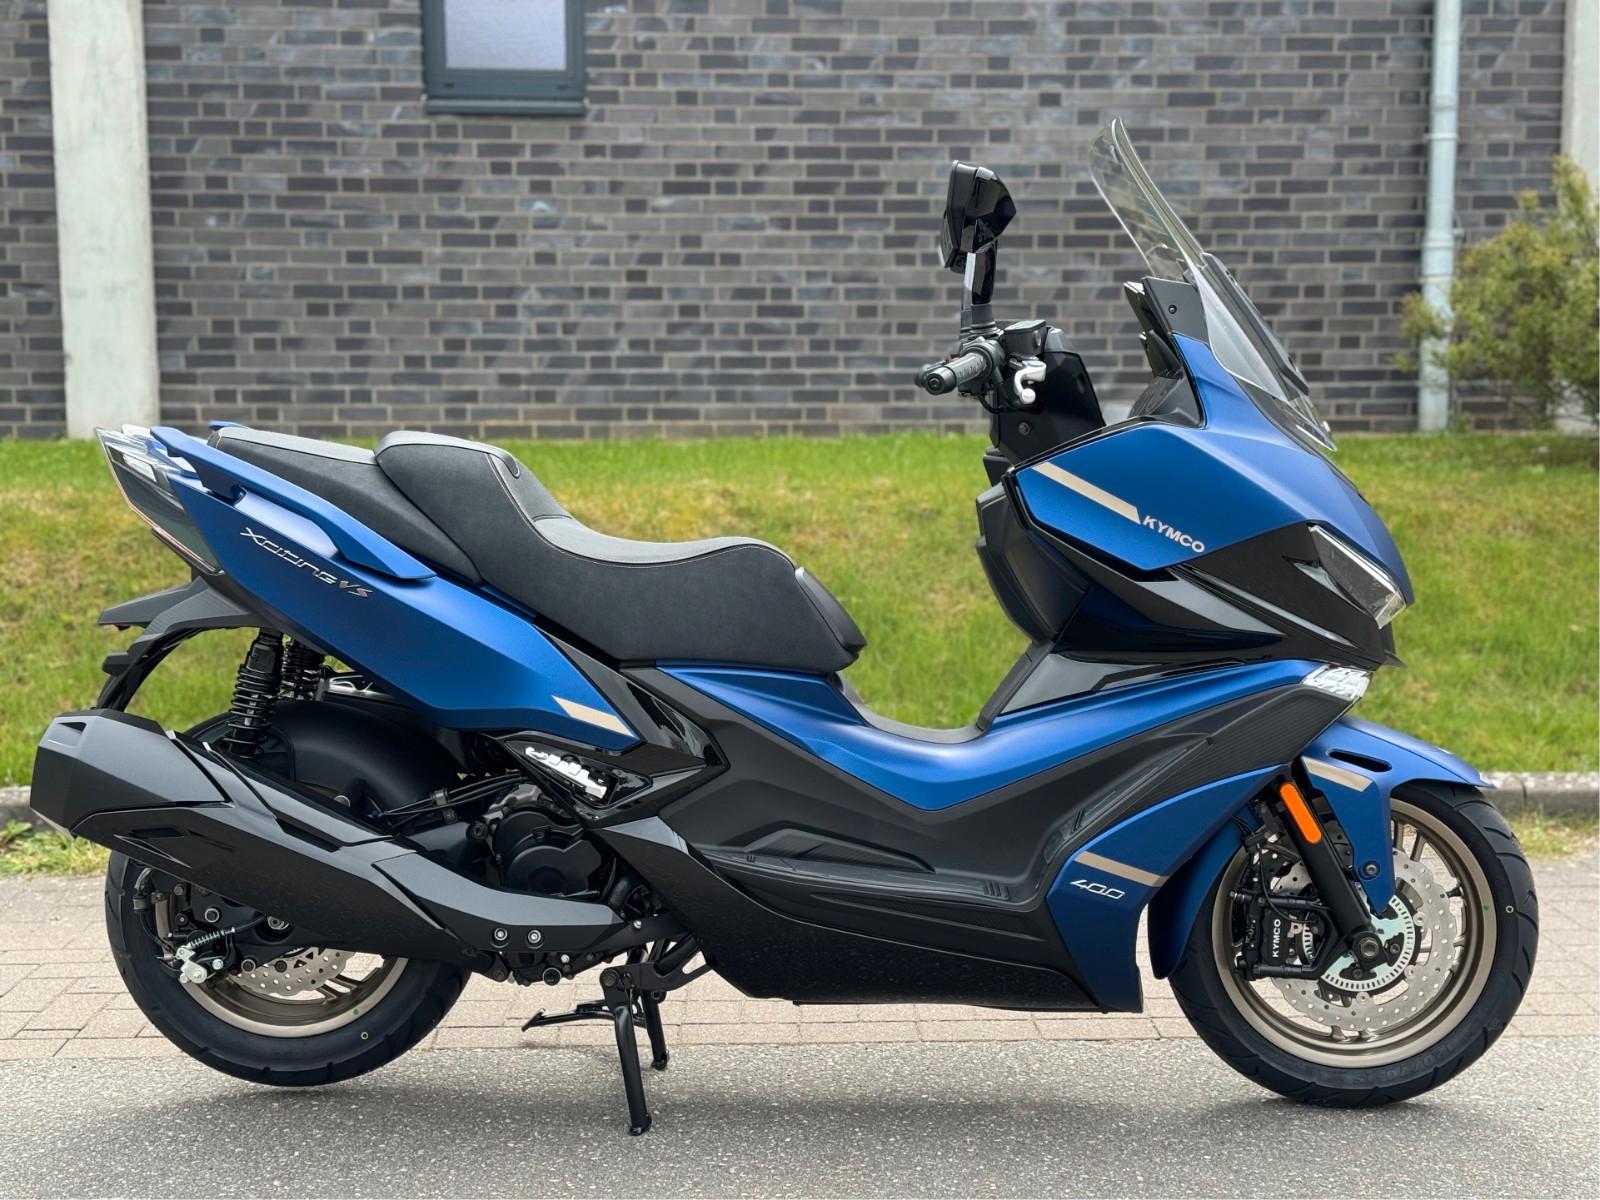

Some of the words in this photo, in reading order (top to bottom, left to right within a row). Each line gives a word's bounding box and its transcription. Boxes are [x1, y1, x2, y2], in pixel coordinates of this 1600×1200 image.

[1142, 514, 1206, 553] KYMCO
[338, 580, 373, 598] VS
[1069, 879, 1126, 900] 400
[1272, 918, 1281, 958] KYMCO
